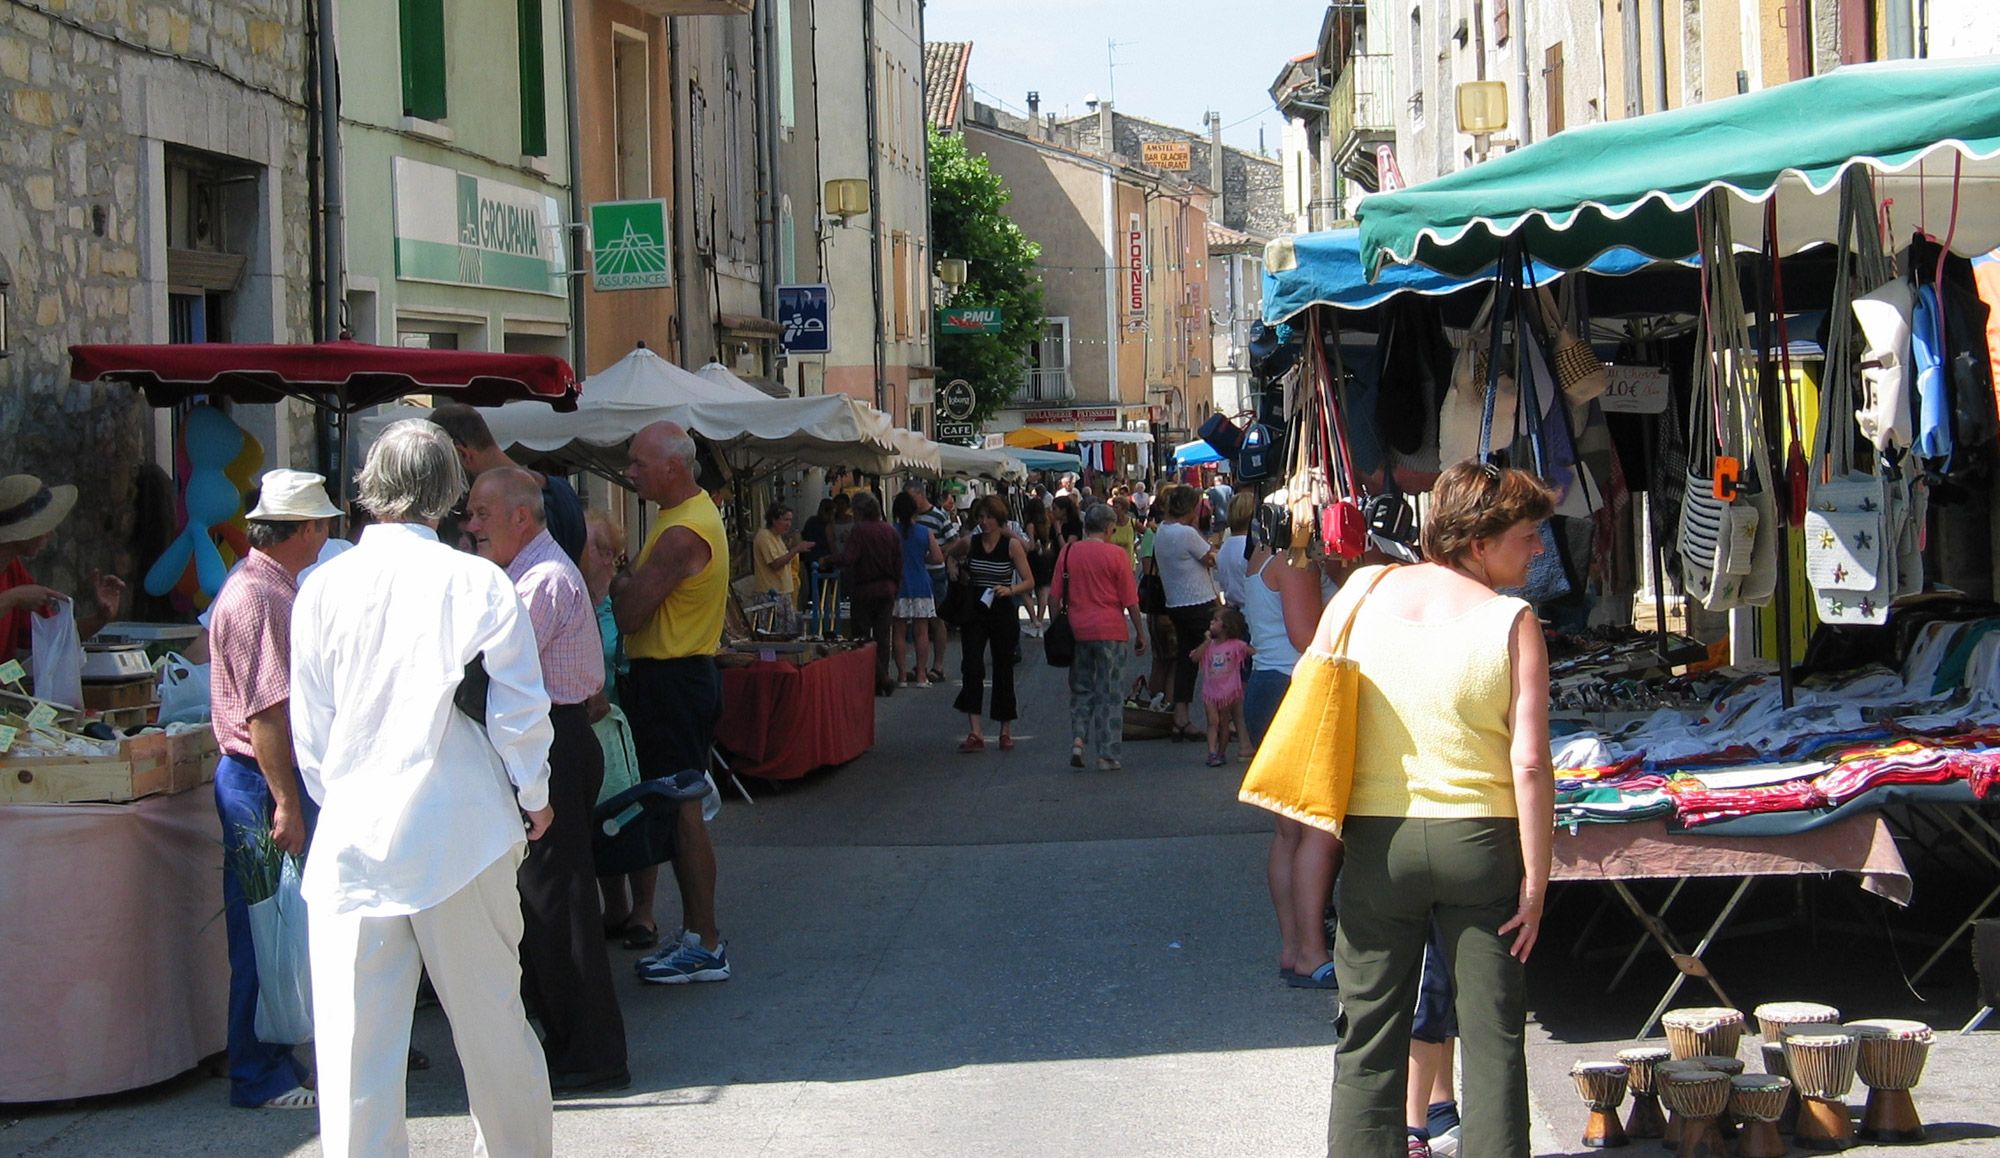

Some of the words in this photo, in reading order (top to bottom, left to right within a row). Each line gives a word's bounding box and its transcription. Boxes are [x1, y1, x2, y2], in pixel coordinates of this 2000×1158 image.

[1146, 144, 1173, 152] AMSTEL
[1144, 153, 1158, 161] BAR
[1160, 152, 1188, 161] GLACIER
[479, 197, 539, 256] GROUPAMA
[1130, 232, 1143, 309] POGNES
[598, 274, 666, 287] ASSURANCES
[963, 310, 994, 322] PMU
